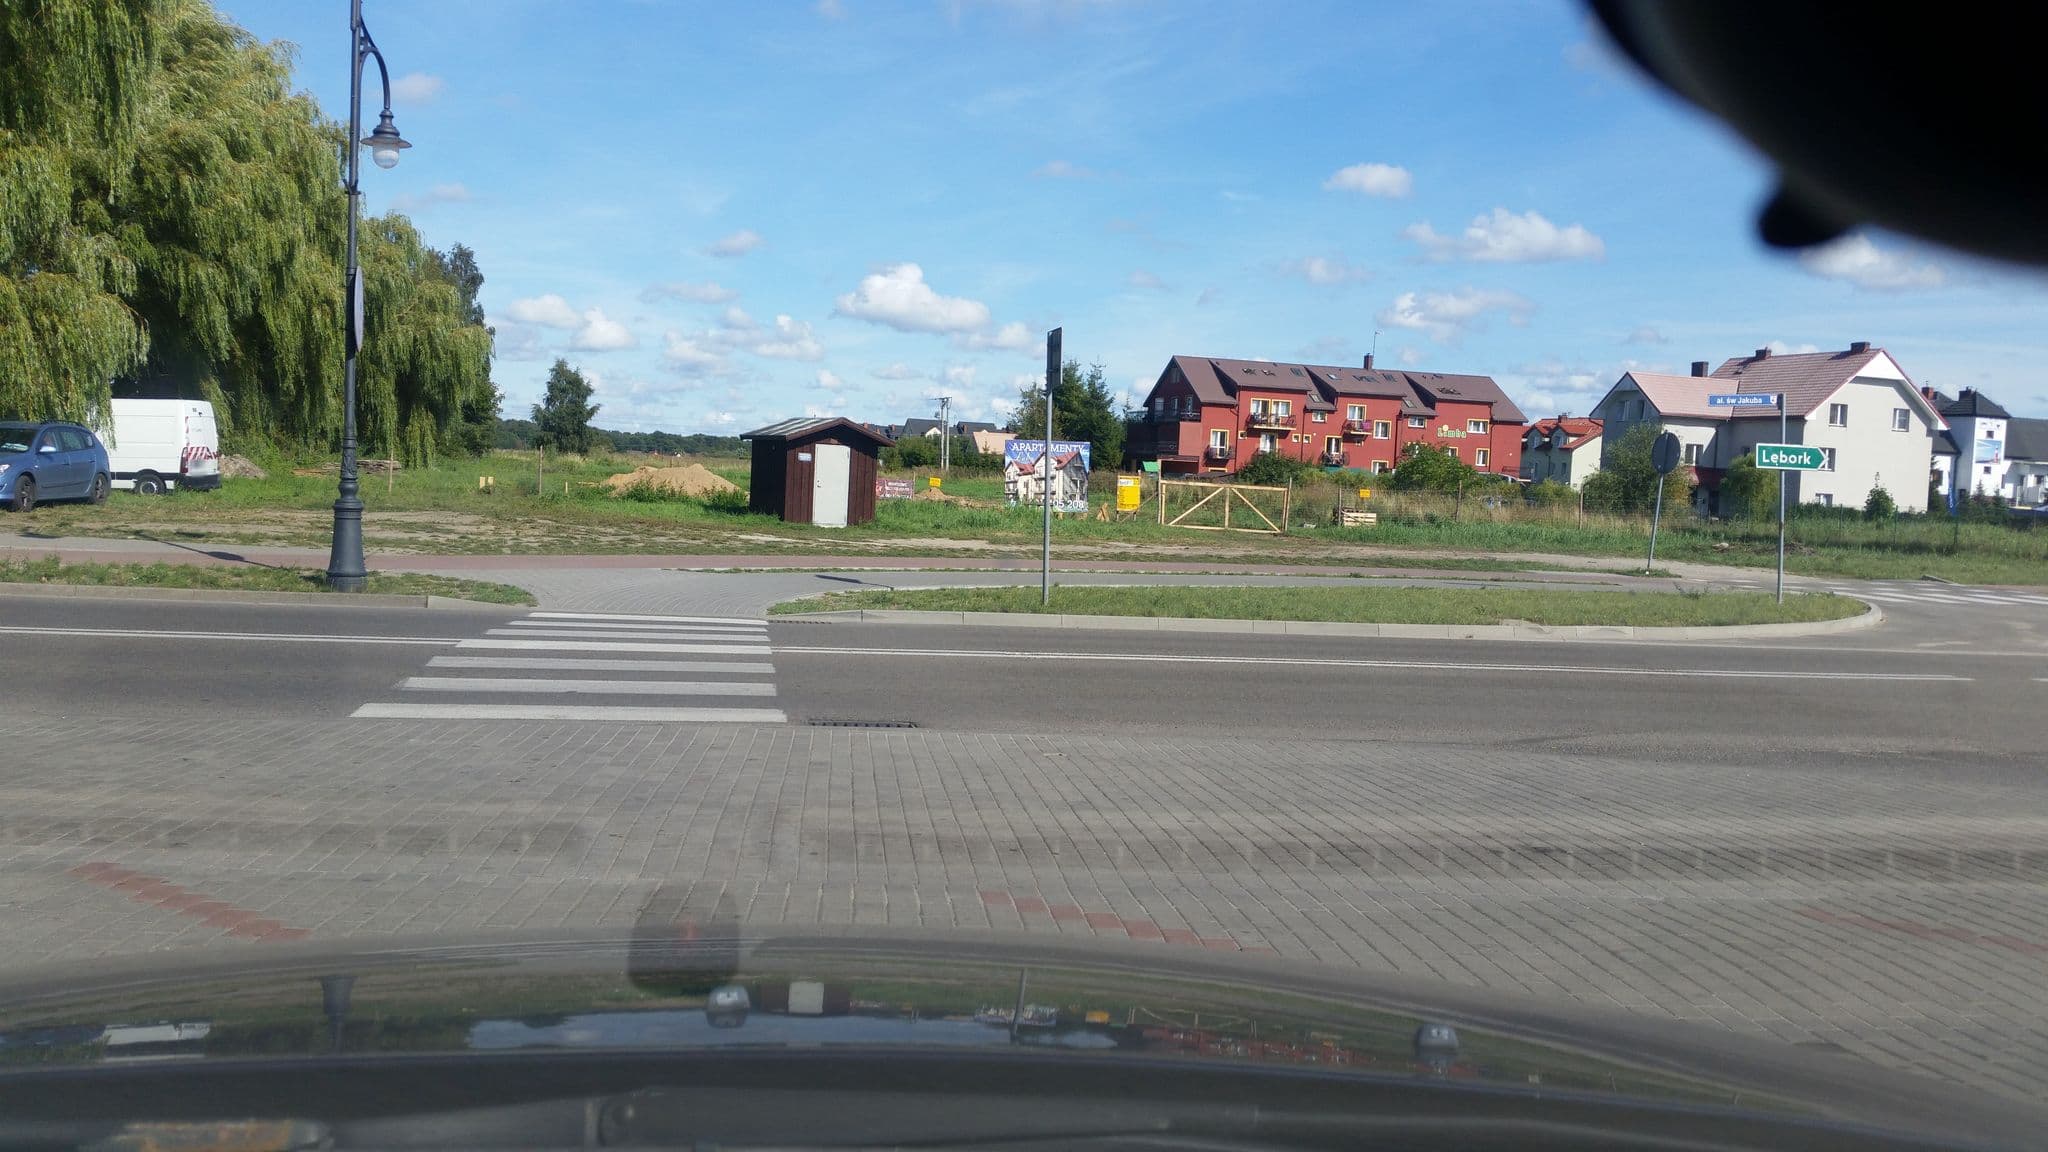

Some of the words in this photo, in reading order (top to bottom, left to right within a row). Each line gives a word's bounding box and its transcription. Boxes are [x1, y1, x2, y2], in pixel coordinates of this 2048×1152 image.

[1737, 396, 1763, 404] Jakuba
[1011, 442, 1084, 452] APARTMENTY
[1762, 449, 1811, 466] Lębork
